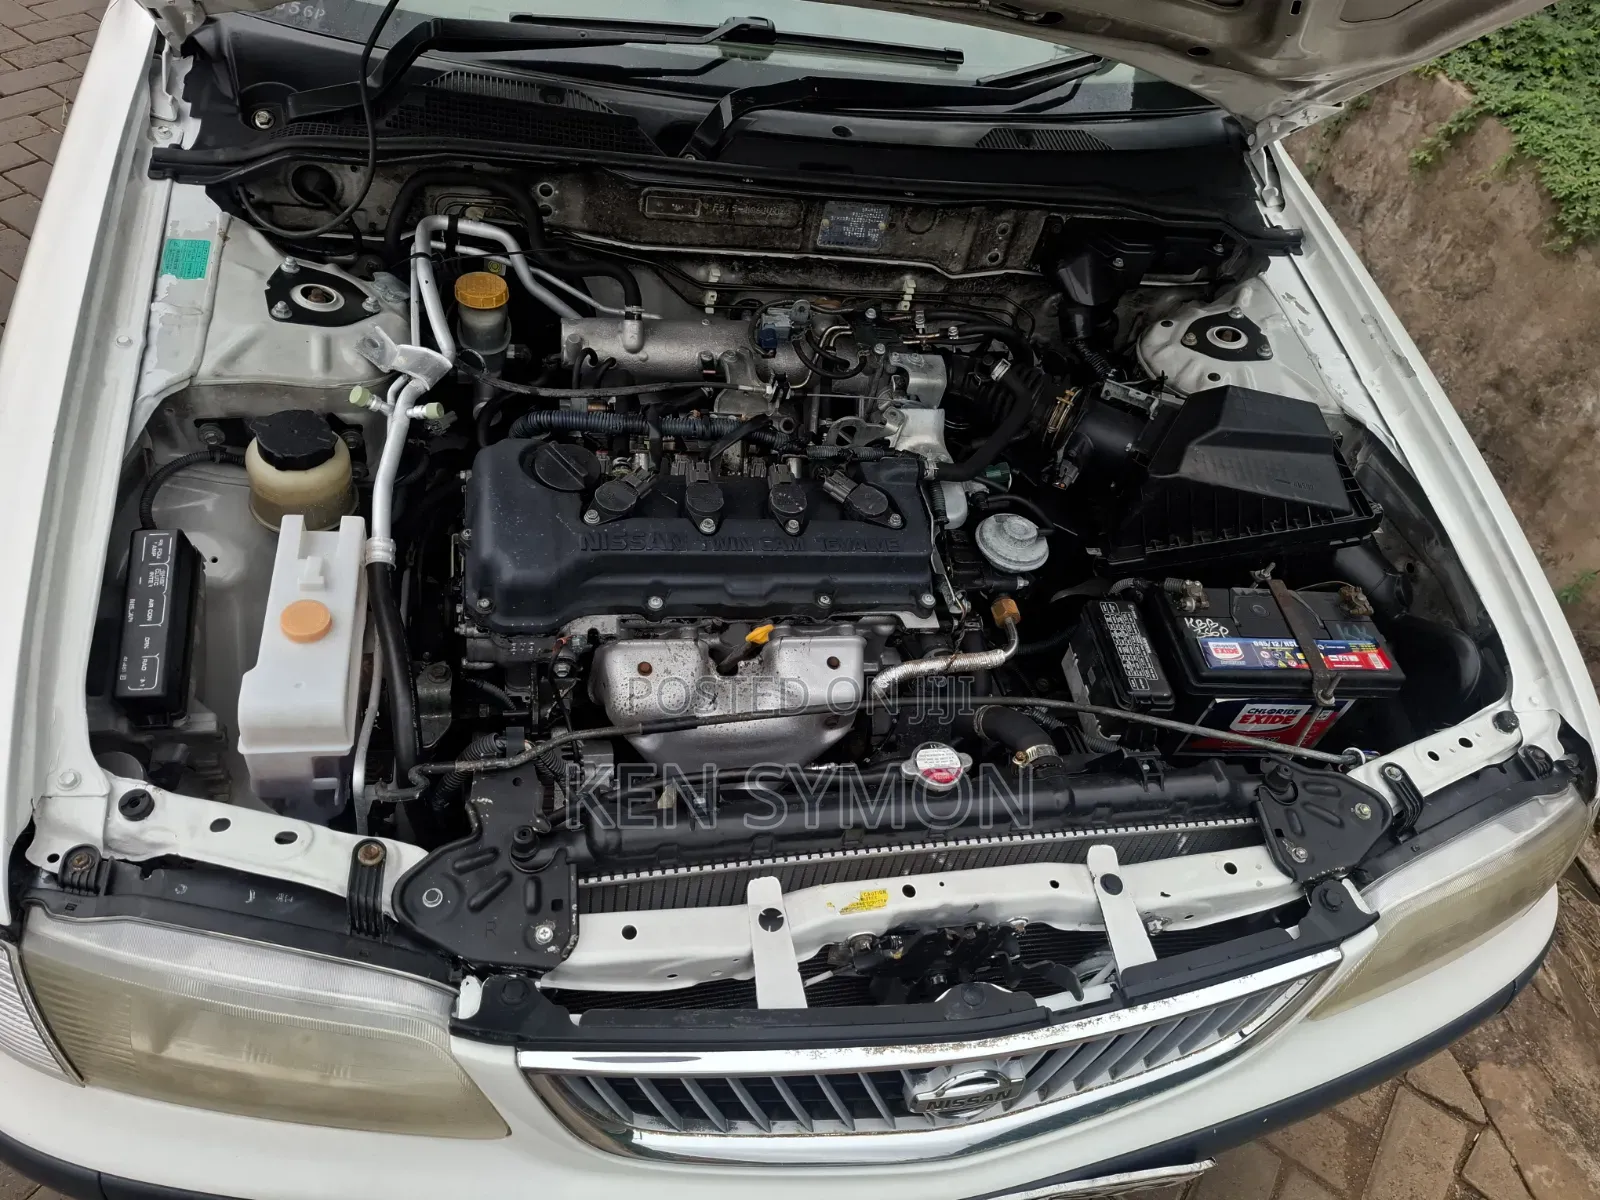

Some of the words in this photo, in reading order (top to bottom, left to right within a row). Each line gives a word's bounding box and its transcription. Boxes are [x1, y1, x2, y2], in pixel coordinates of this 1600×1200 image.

[579, 531, 687, 552] NISSAN
[701, 537, 753, 552] TWIN
[760, 537, 804, 552] CAM
[1183, 617, 1219, 630] KBB
[1213, 647, 1241, 655] EXIDE
[1247, 707, 1302, 715] CHLORIDE
[1238, 715, 1298, 725] EXIDE
[486, 921, 497, 938] R
[926, 1089, 1013, 1111] NISSAN
